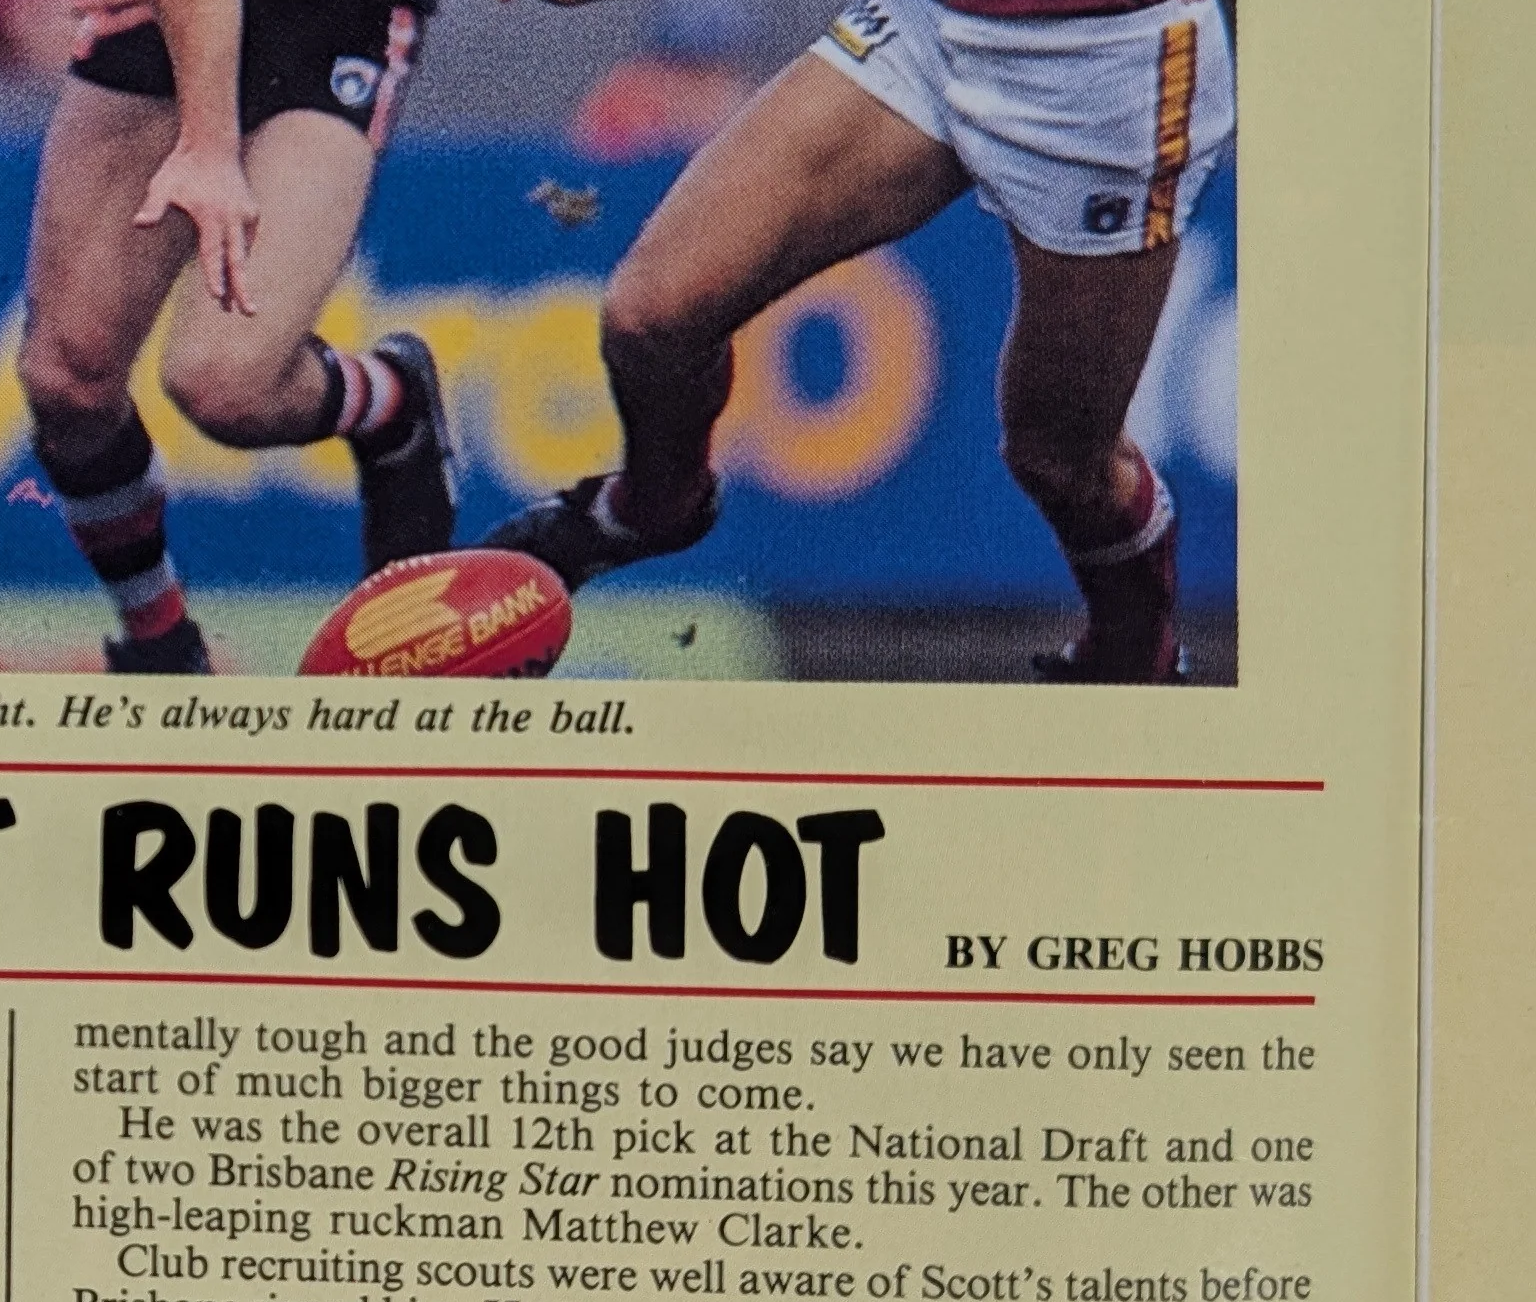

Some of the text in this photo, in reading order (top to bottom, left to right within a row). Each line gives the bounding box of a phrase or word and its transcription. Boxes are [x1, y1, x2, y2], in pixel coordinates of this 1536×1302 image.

[466, 579, 547, 645] BANK
[57, 694, 145, 729] He’s
[160, 695, 292, 737] always
[306, 697, 400, 732] hard
[414, 703, 454, 733] at
[470, 699, 532, 734] the
[549, 699, 634, 735] ball.
[100, 800, 501, 959] RUNS
[595, 809, 885, 965] HOT
[944, 934, 1324, 973] BY GREG HOBBS
[74, 1015, 1315, 1078] mentally tough and the good judges say we have only seen the
[71, 1194, 864, 1250] high-leaping ruckman Matthew Clarke.
